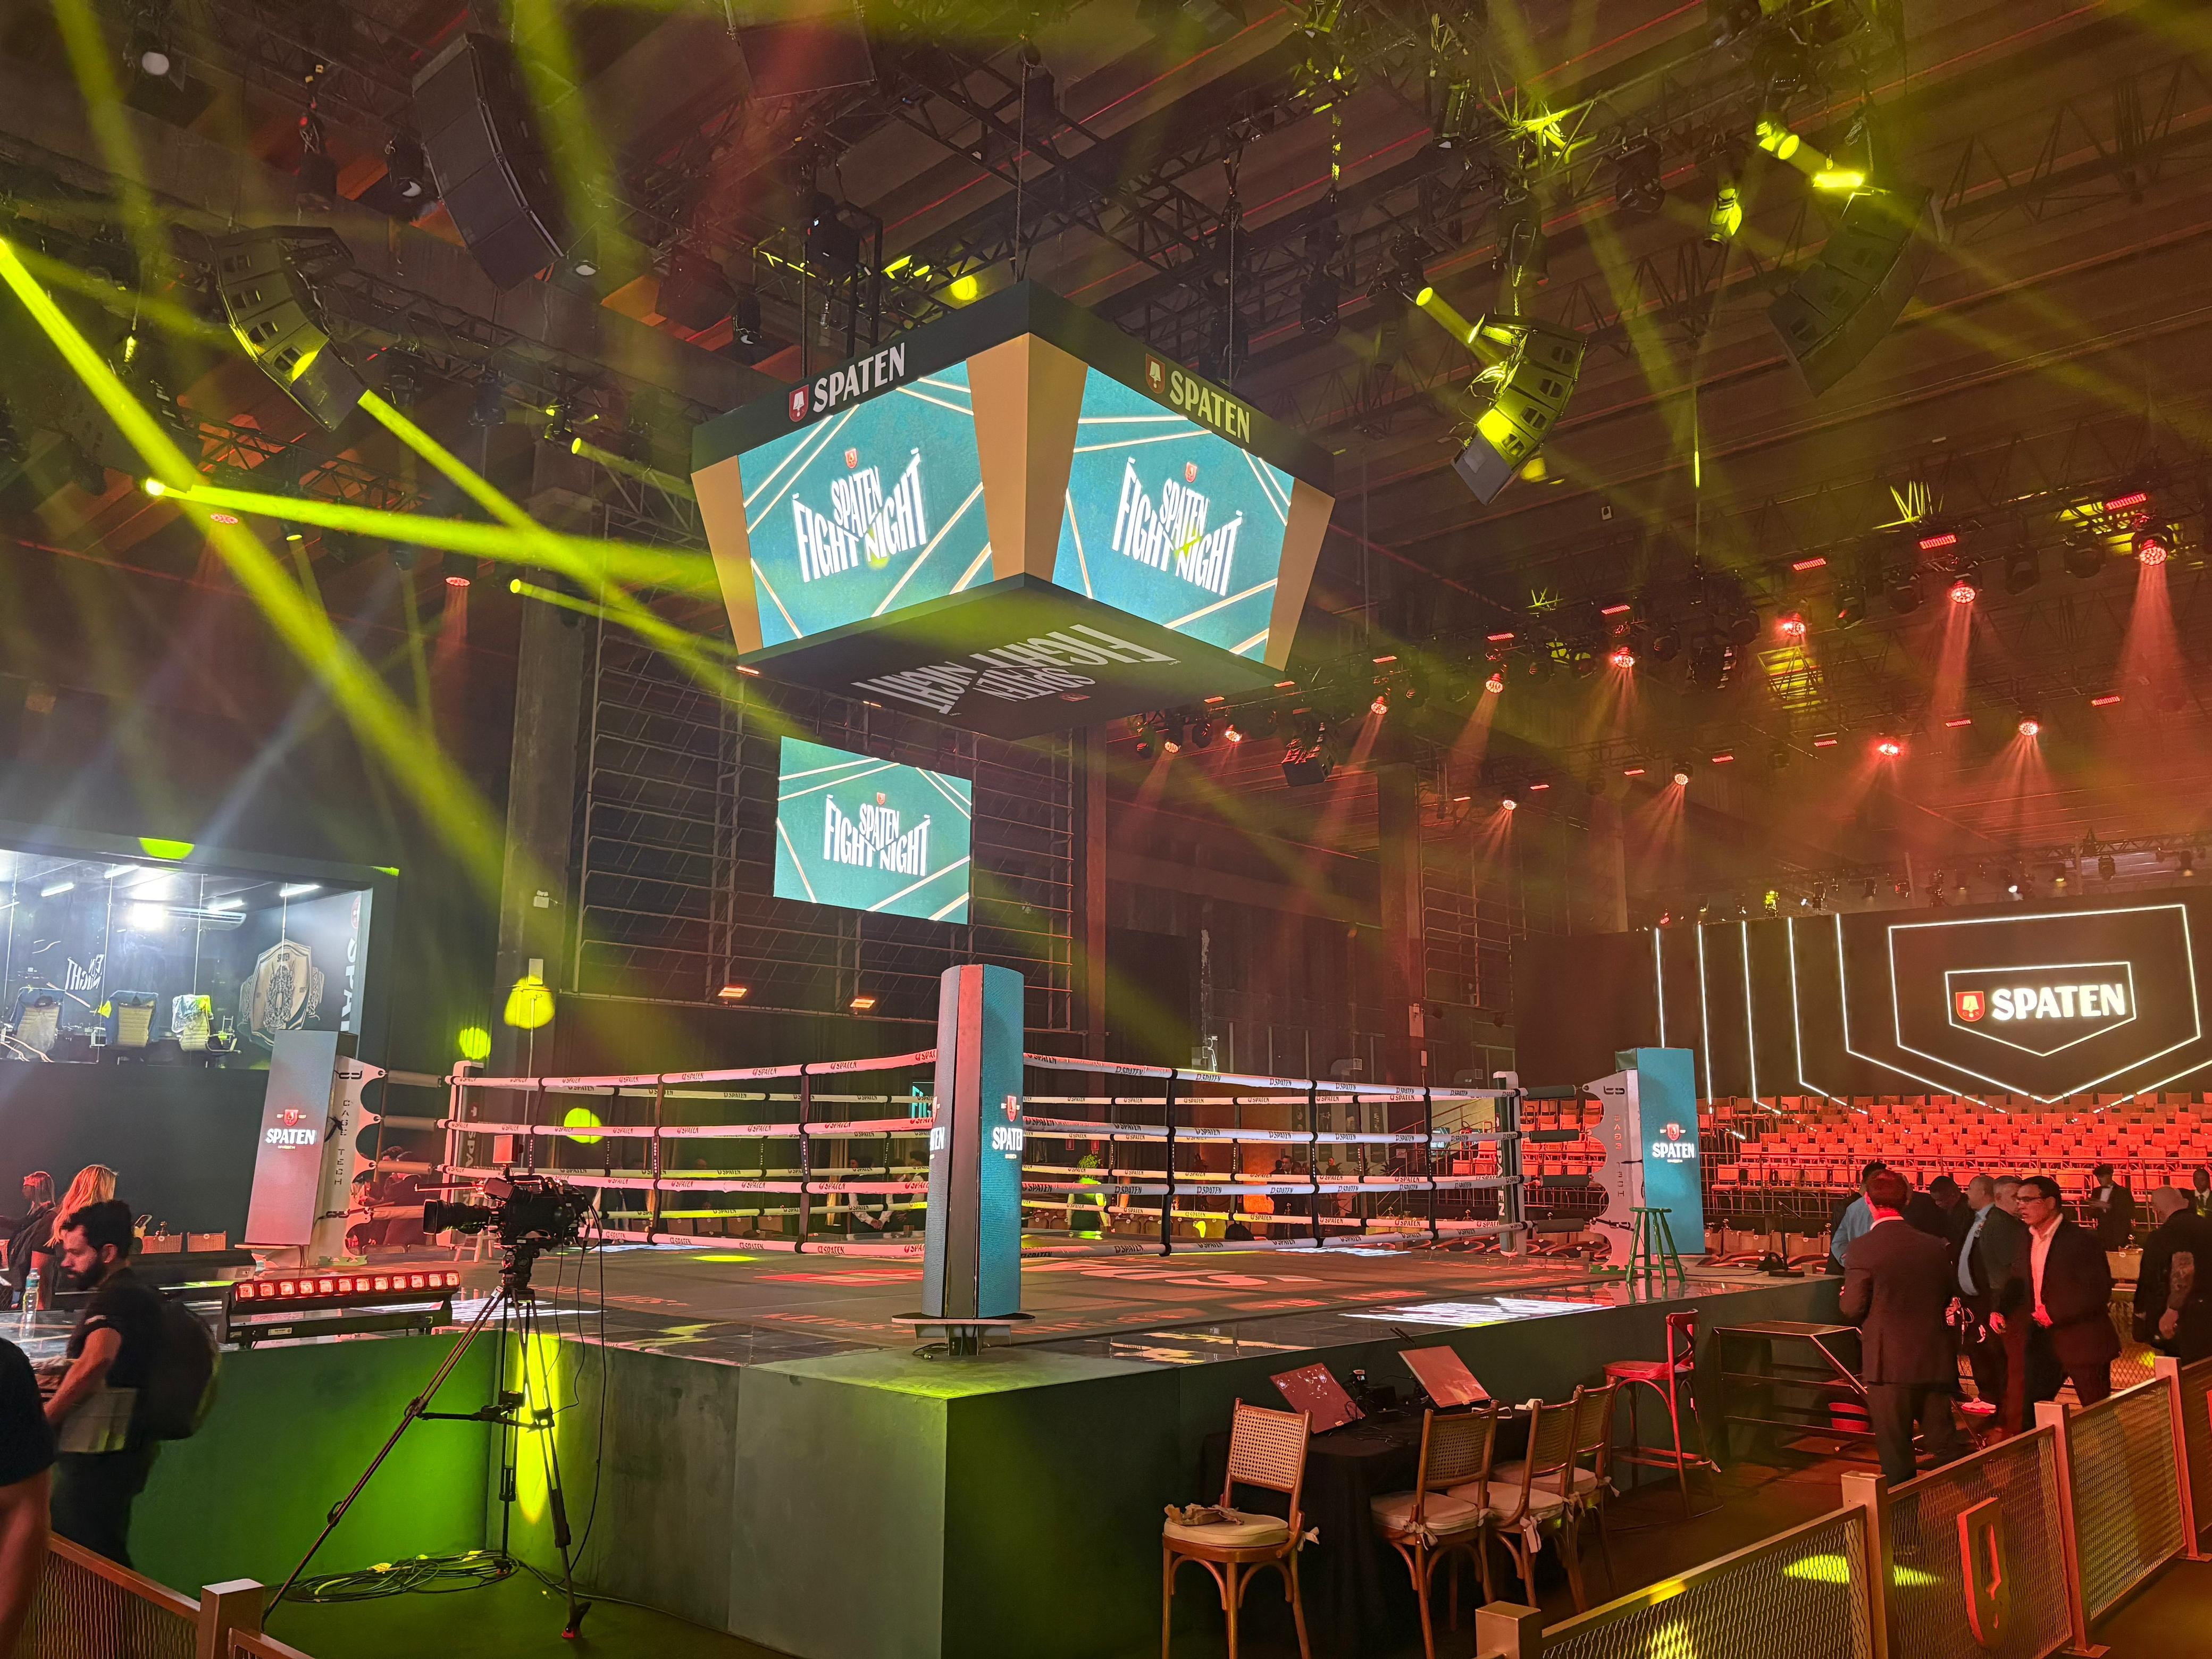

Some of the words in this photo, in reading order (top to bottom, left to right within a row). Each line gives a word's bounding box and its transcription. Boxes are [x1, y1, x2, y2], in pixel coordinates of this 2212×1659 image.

[813, 342, 905, 413] SPATEN
[1170, 371, 1250, 443] SPATEN
[831, 465, 883, 538] SPATEN
[792, 499, 859, 583] FIGHT
[865, 453, 927, 562] NIGHT
[1159, 478, 1210, 550] SPATEN
[1112, 462, 1174, 572] FIGHT
[1175, 516, 1242, 596] NIGHT
[969, 624, 1177, 668] FIGHT
[851, 661, 978, 715] NIGHT
[973, 667, 1096, 701] SPATEN
[824, 797, 876, 867] FIGHT
[879, 818, 931, 876] NIGHT
[859, 803, 900, 851] SPATEN
[1992, 984, 2126, 1020] SPATEN
[835, 1060, 858, 1070] SPATEN
[1034, 1054, 1057, 1065] SPATEN
[758, 1067, 778, 1076] SPATEN
[1121, 1066, 1143, 1076] SPATEN
[1202, 1074, 1221, 1083] SPATEN
[266, 1128, 316, 1145] SPATEN
[992, 1127, 1023, 1151] SPATE
[1201, 1128, 1220, 1136] SPATEN
[1652, 1142, 1695, 1158] SPATEN
[824, 1182, 847, 1191] SPATEN
[1028, 1184, 1053, 1193] SPATEN
[1120, 1186, 1142, 1194] SPATEN
[823, 1246, 845, 1255] SPATEN
[1120, 1244, 1144, 1253] SPATEN
